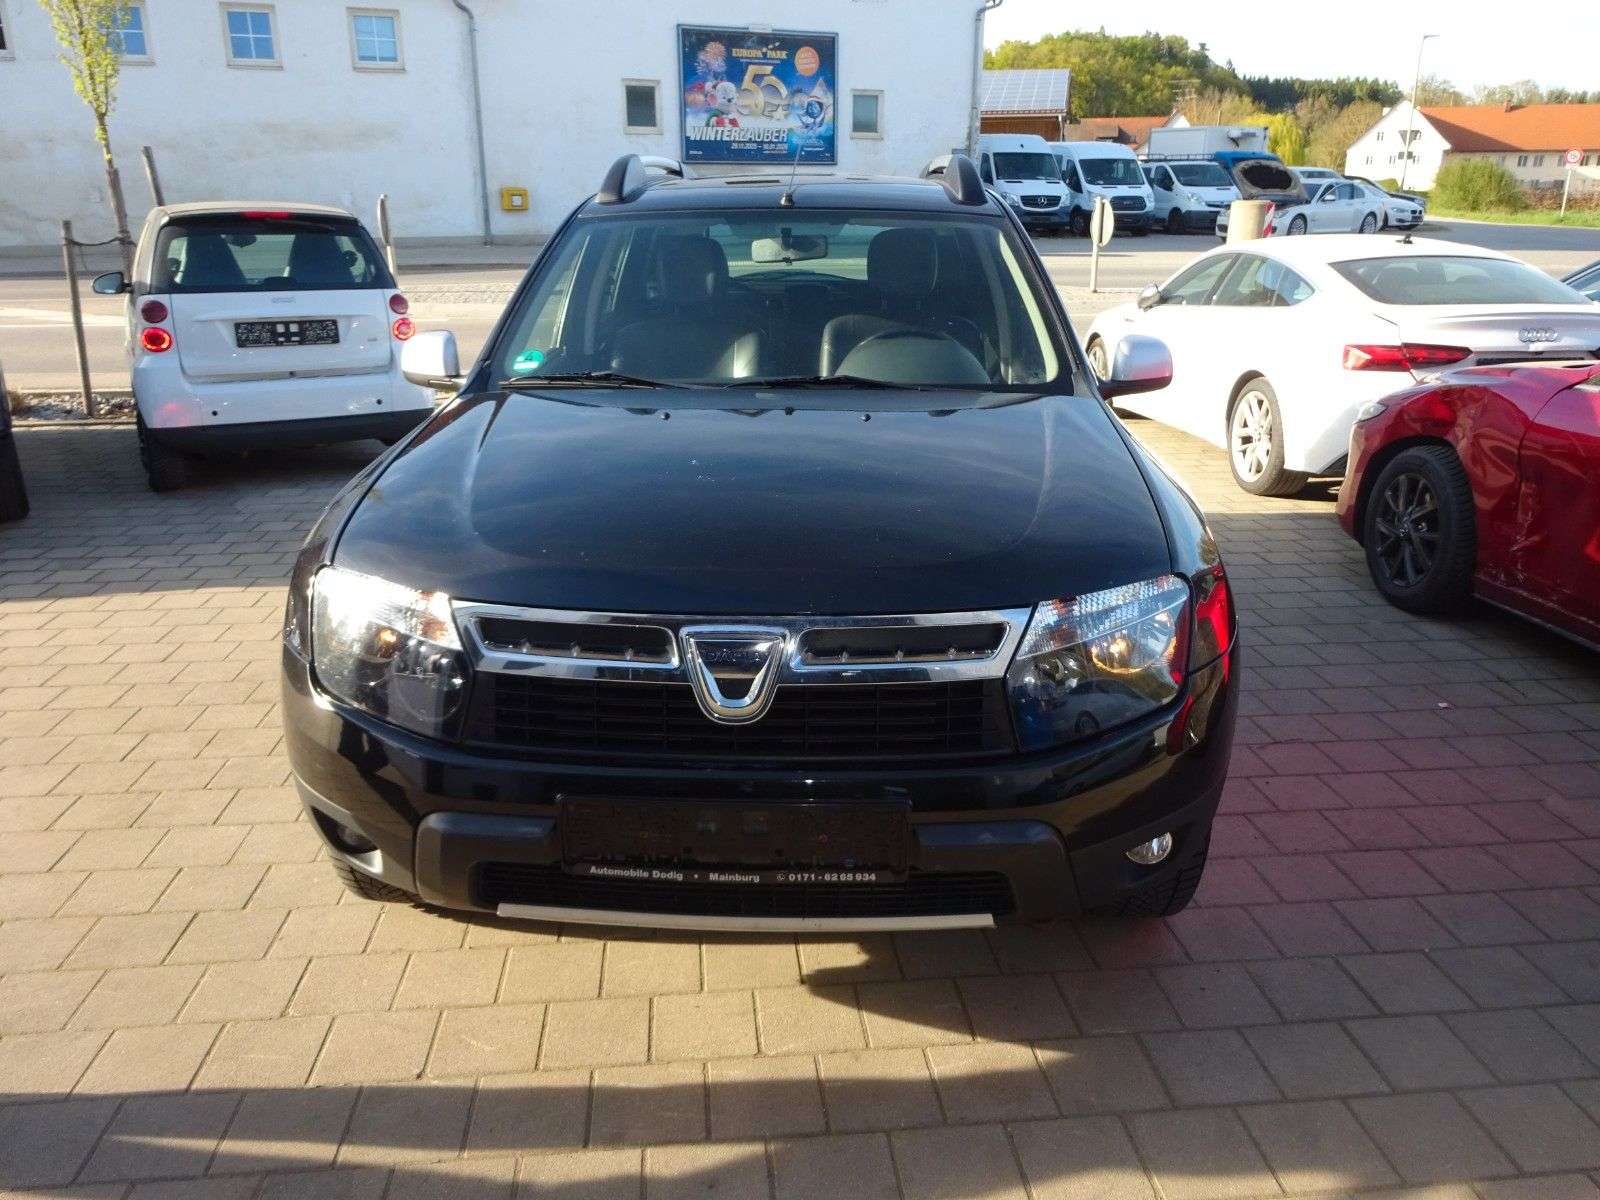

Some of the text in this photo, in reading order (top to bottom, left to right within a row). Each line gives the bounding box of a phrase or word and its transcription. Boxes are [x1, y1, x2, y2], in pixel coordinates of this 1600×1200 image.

[690, 127, 788, 142] WINTERZAUBER
[590, 865, 649, 878] Automobile
[652, 870, 684, 881] Dodig
